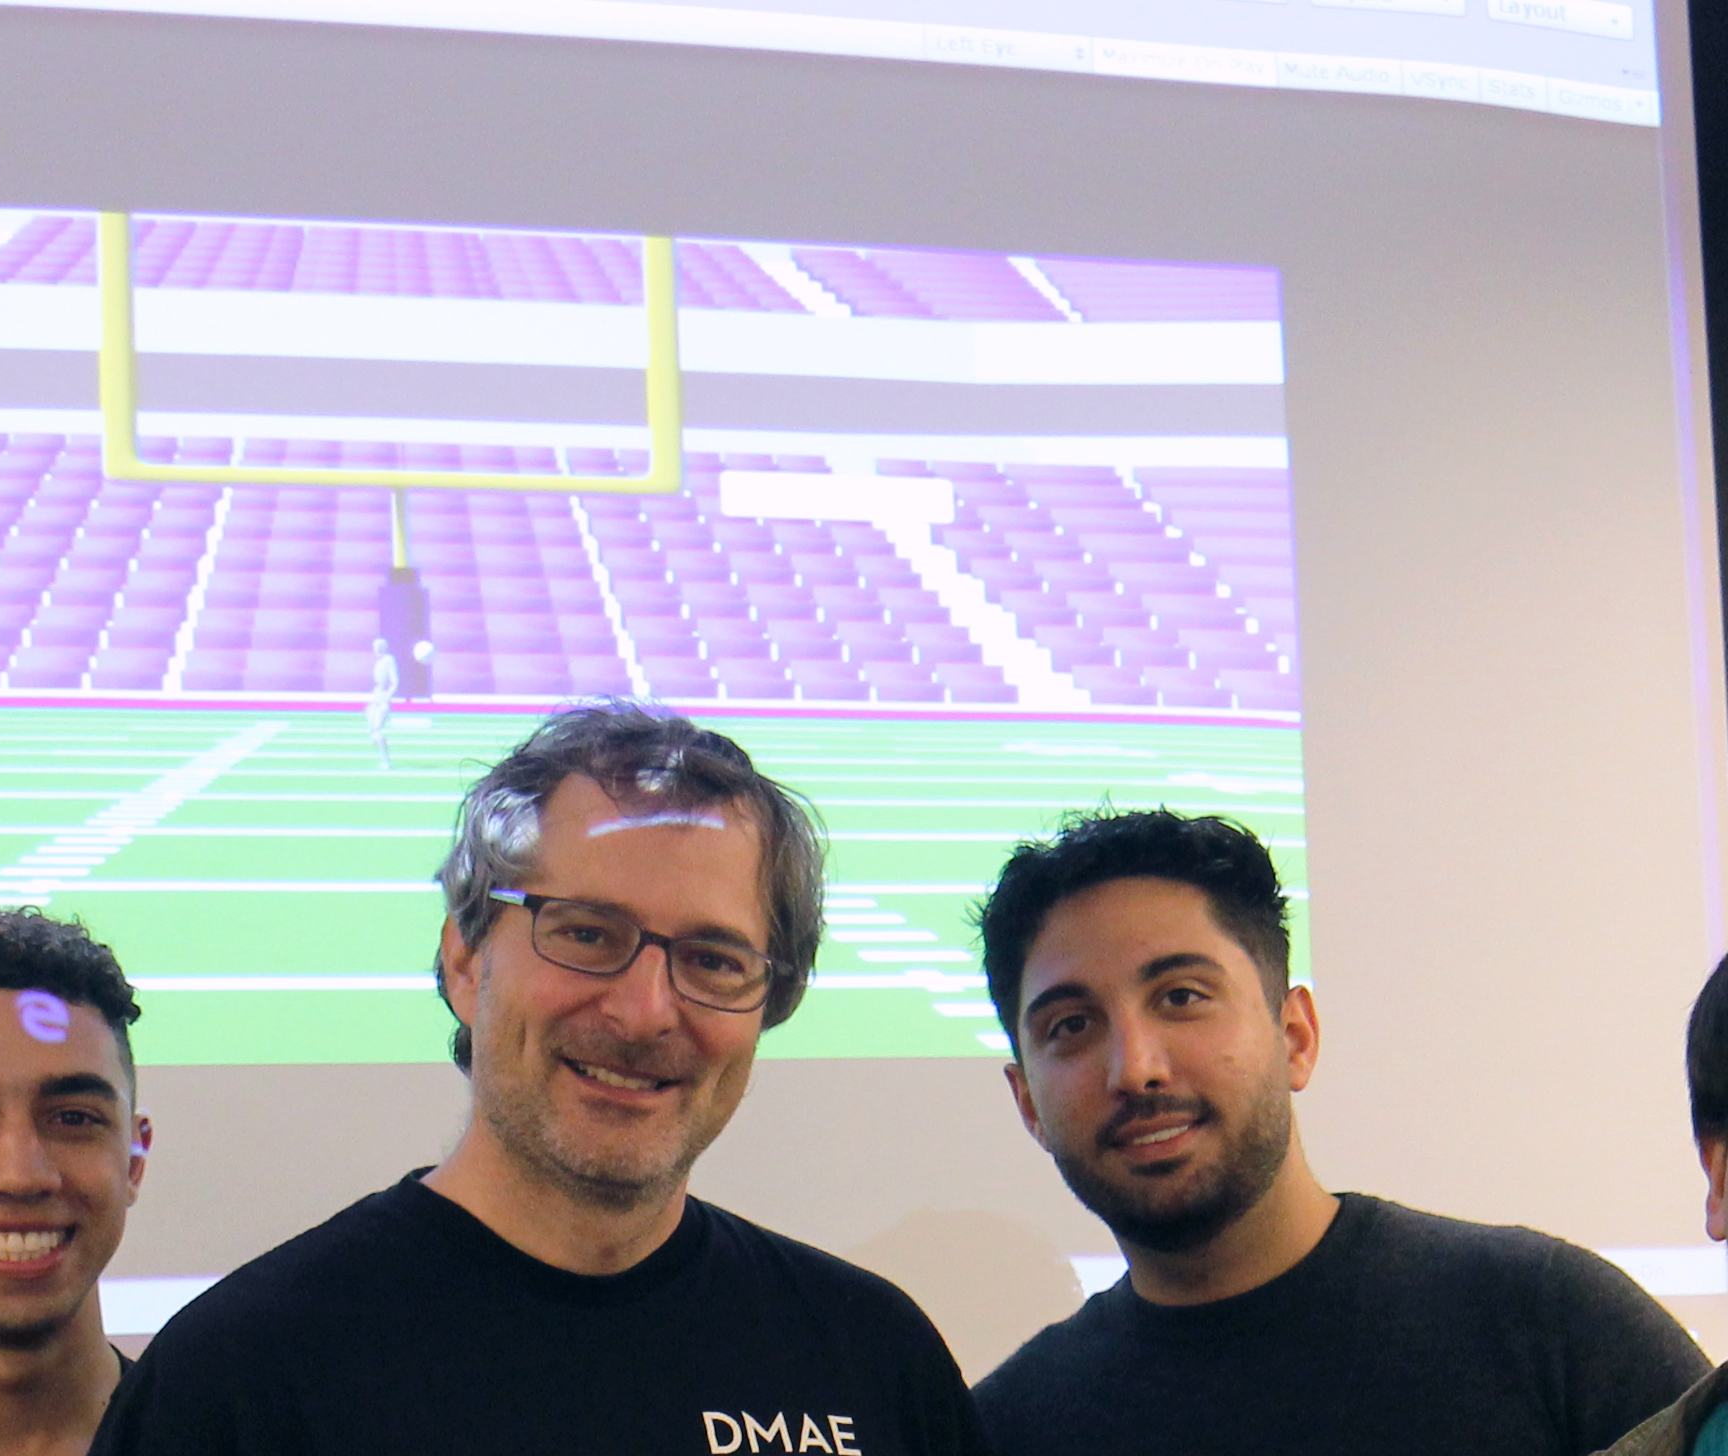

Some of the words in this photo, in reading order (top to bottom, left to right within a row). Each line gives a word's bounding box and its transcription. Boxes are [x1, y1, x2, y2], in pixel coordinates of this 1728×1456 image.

[1499, 0, 1567, 22] Layout
[935, 34, 975, 54] Left
[982, 37, 1018, 59] Eye
[1283, 61, 1330, 82] Mute
[1336, 64, 1390, 84] Audio
[1409, 70, 1470, 93] VSync
[1487, 78, 1536, 101] Stats
[1558, 88, 1624, 112] Gizmos
[702, 1410, 863, 1456] DMAE
